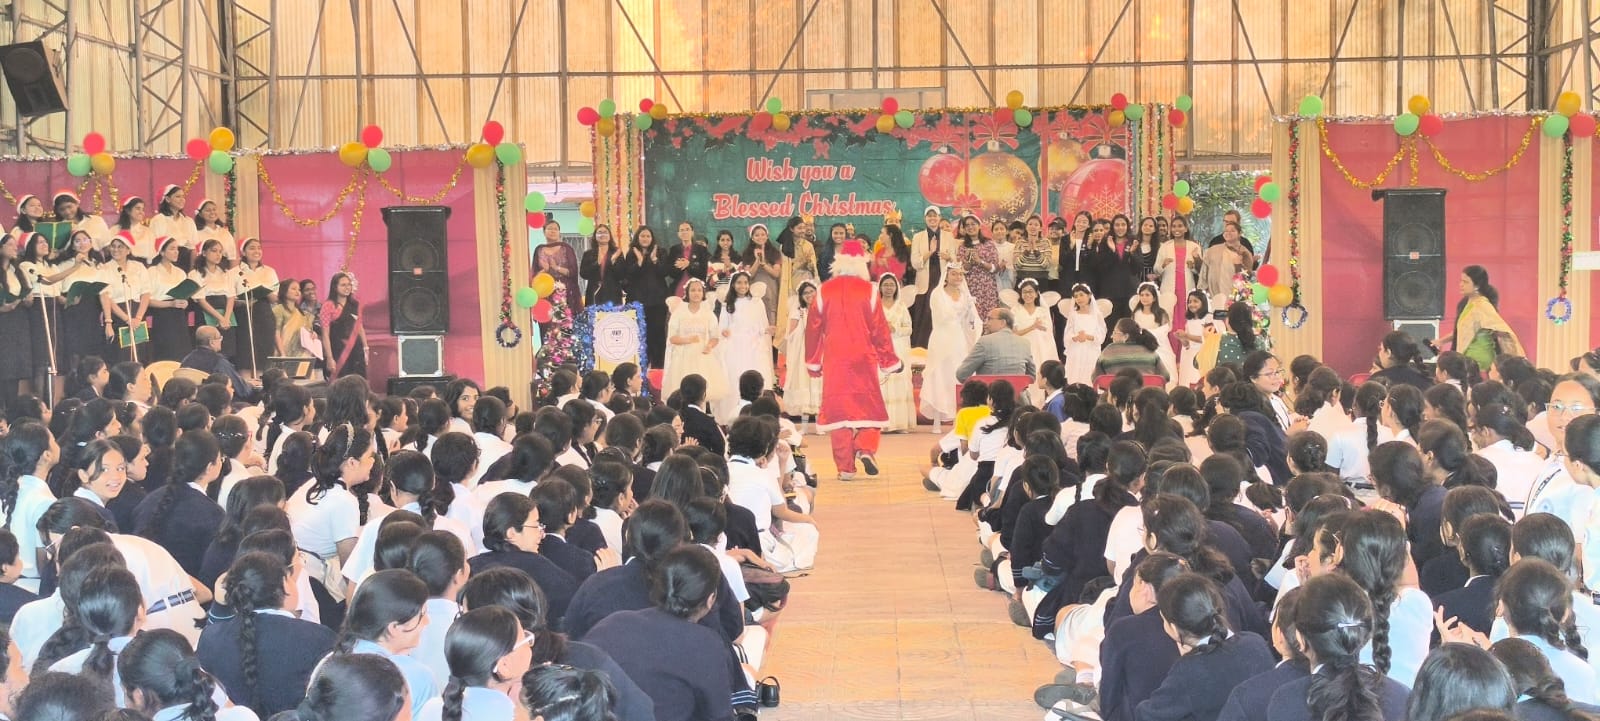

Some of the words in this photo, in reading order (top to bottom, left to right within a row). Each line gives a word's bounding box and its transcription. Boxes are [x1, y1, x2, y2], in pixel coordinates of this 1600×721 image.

[747, 157, 798, 181] Wish
[800, 165, 837, 189] you
[839, 165, 856, 180] a
[713, 193, 795, 219] Blessed
[798, 190, 896, 216] Christmas
